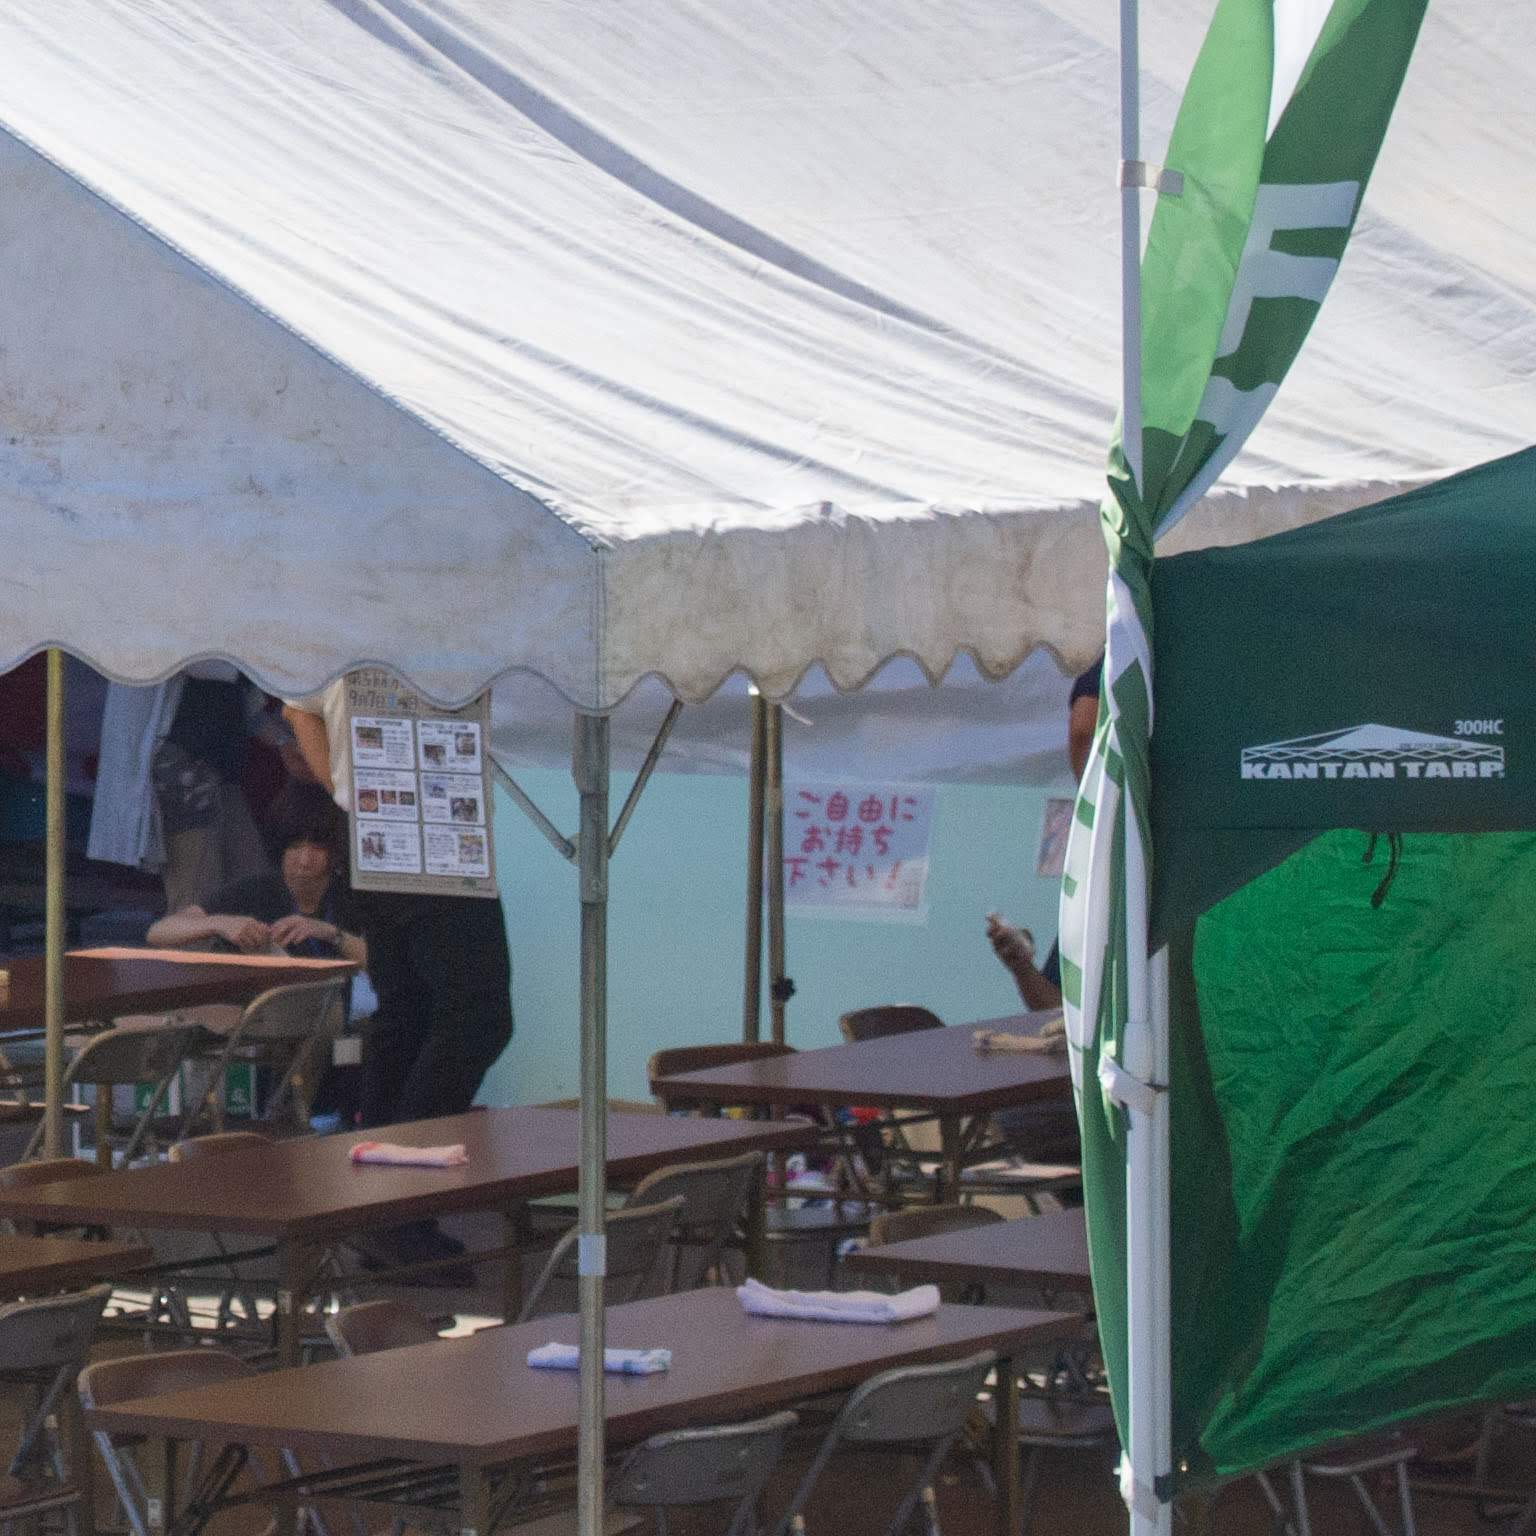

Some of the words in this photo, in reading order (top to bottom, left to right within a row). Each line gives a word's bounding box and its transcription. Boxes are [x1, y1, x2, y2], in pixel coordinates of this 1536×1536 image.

[1454, 719, 1504, 735] 300HC
[1241, 762, 1396, 779] KANTAN
[1401, 761, 1504, 778] TARP
[793, 790, 918, 823] ご自由に
[800, 824, 895, 856] お持ち
